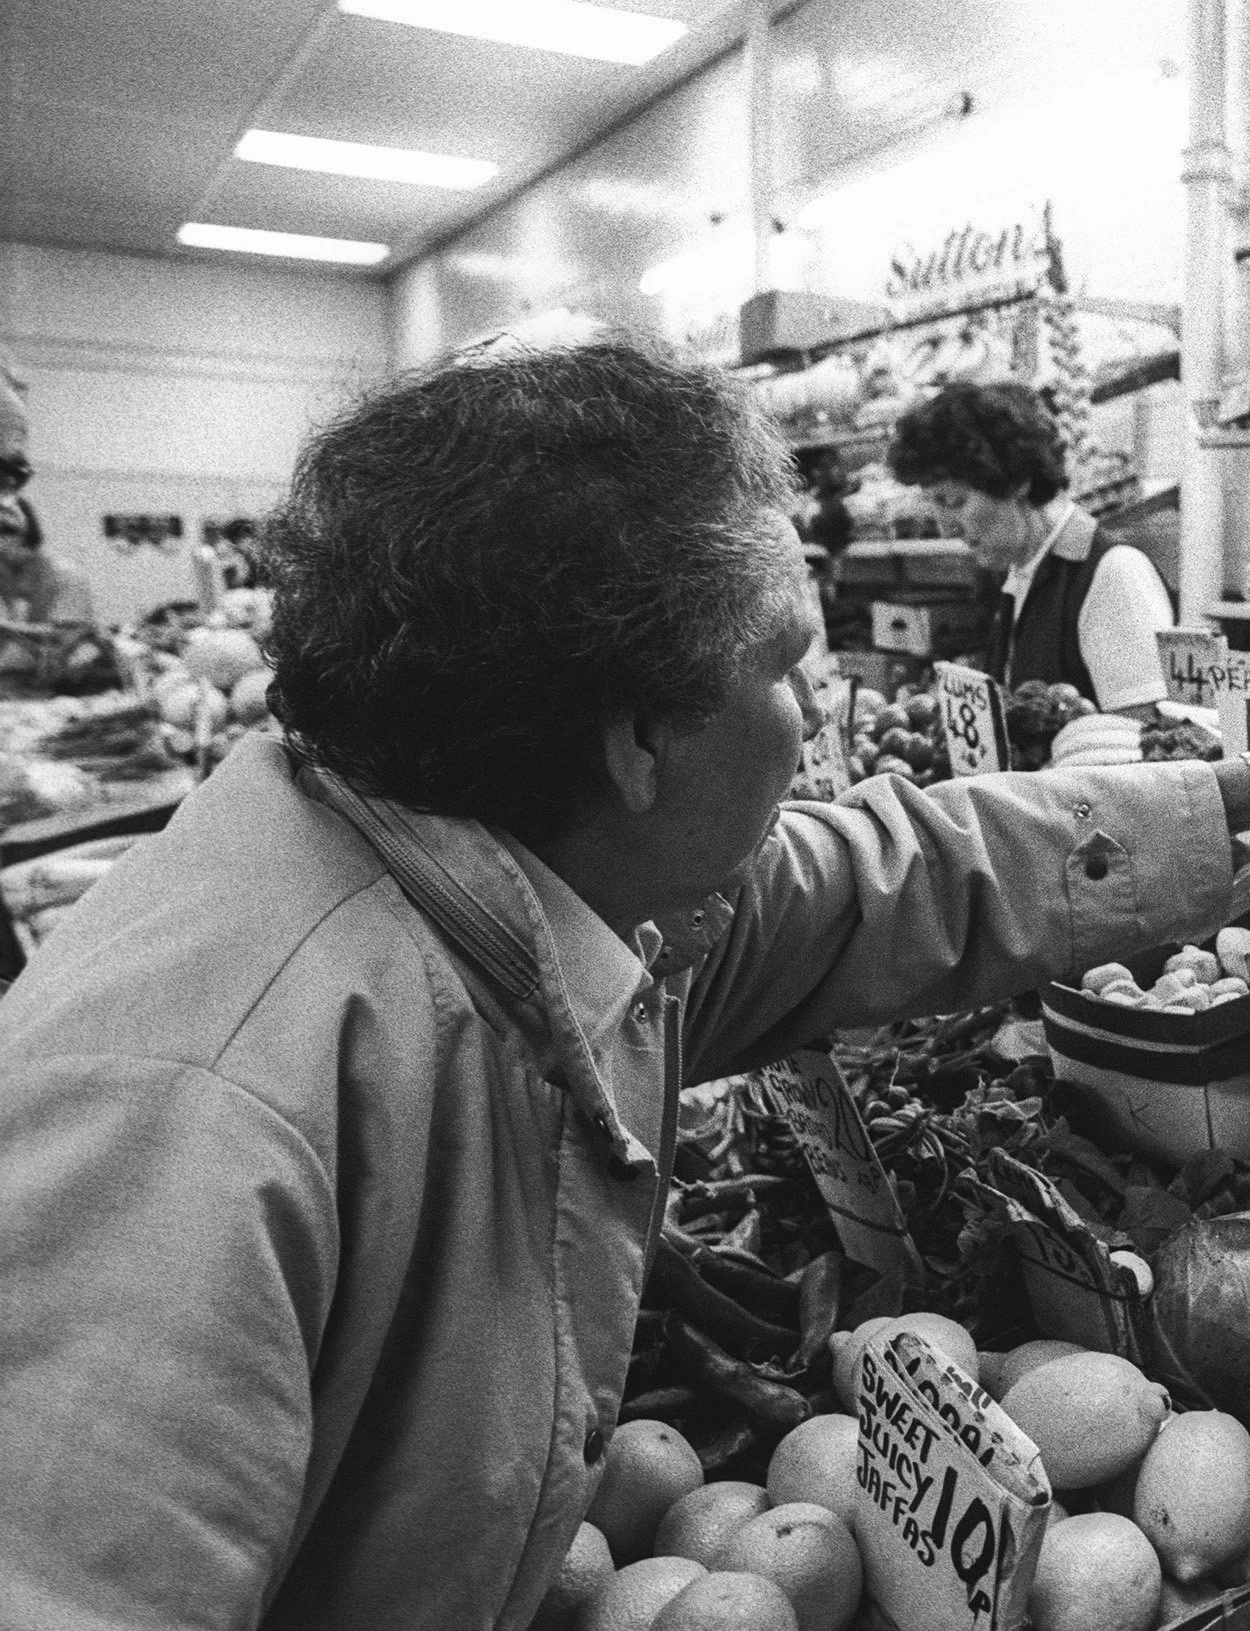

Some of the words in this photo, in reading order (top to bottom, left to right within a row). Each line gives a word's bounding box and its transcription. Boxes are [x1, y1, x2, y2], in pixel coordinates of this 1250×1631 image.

[947, 698, 979, 749] 48
[859, 1394, 935, 1514] JUICY
[862, 1353, 941, 1464] SWEET
[857, 1440, 935, 1567] JAFFAS
[931, 1466, 996, 1586] 10
